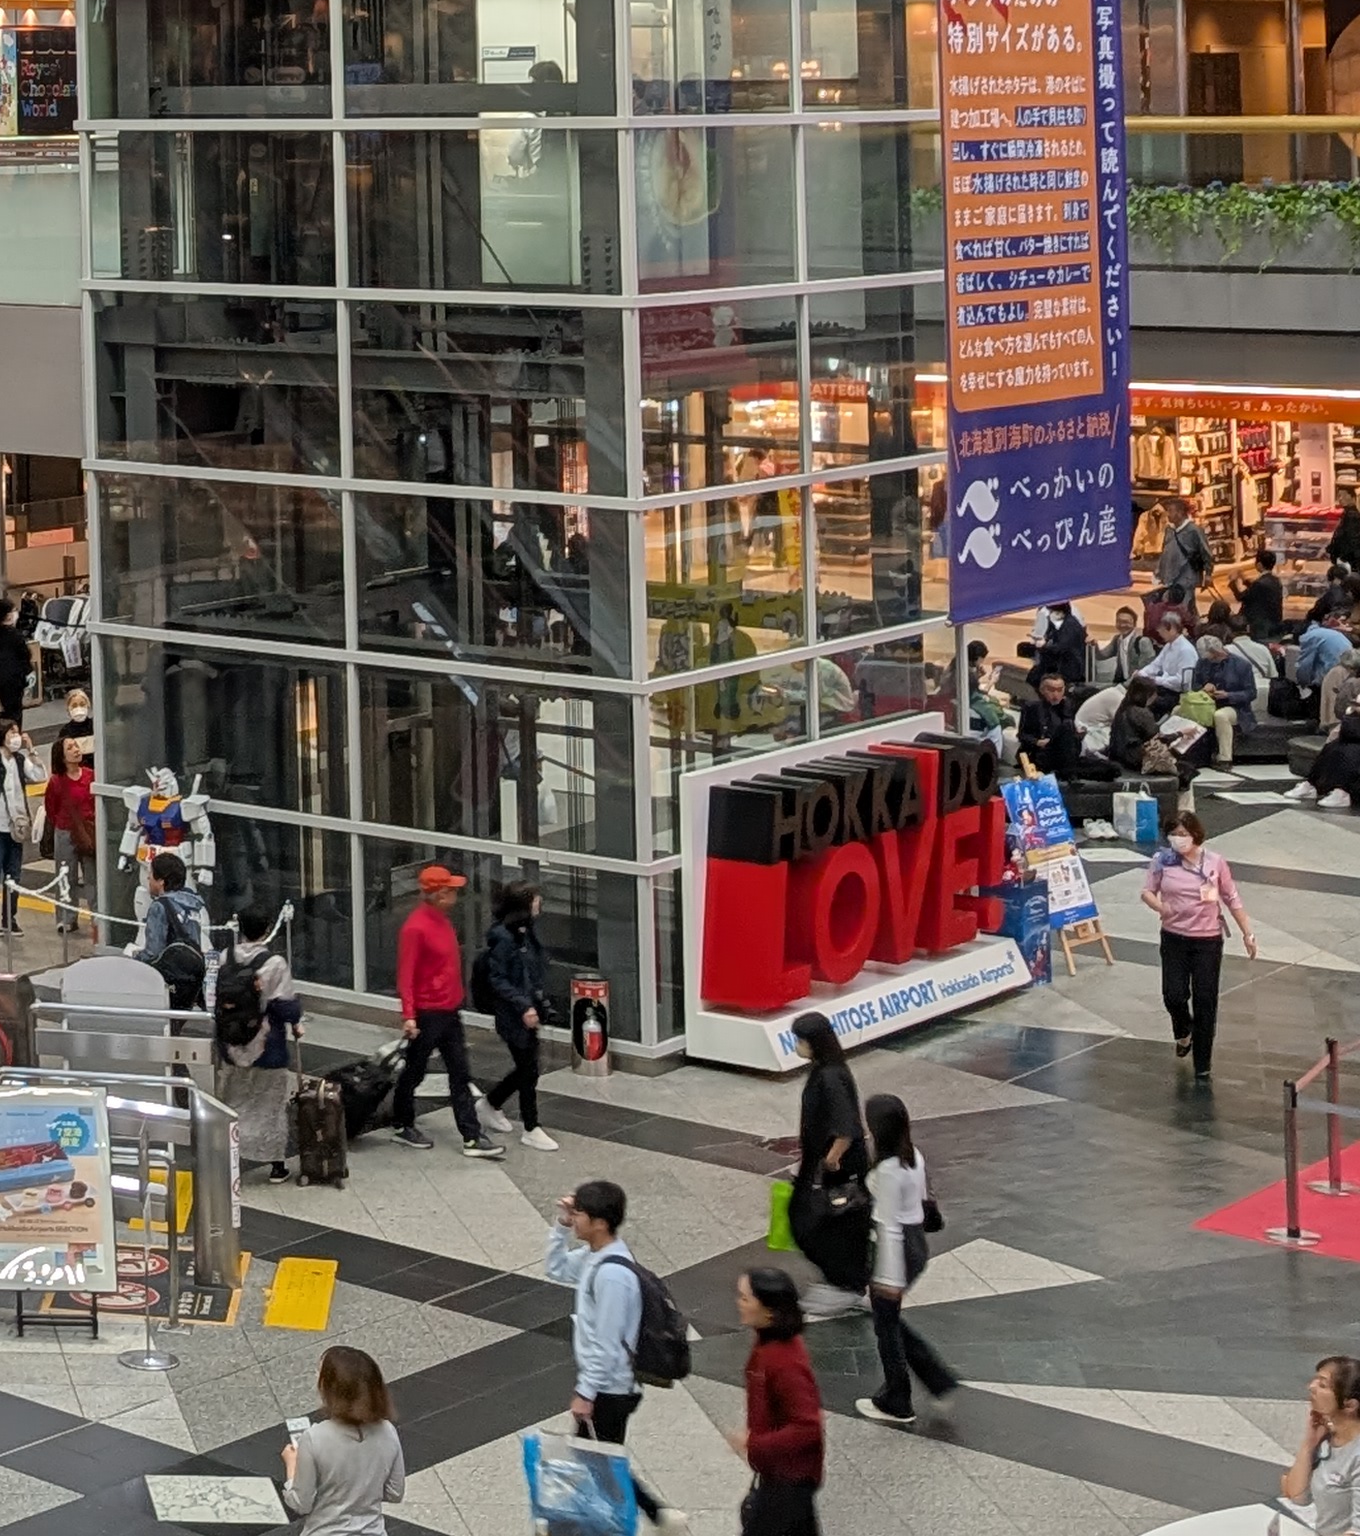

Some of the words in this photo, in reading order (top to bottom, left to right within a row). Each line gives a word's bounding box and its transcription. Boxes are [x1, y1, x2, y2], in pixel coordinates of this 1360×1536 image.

[948, 21, 1082, 54] 特別サイズがある。
[21, 99, 58, 117] World
[959, 412, 1111, 457] 北海道別海町のふるさと納税
[1010, 463, 1114, 499] べっかいの
[1011, 504, 1118, 552] べっぴん産
[830, 999, 880, 1038] HITOSE
[878, 979, 940, 1026] AIRPORT
